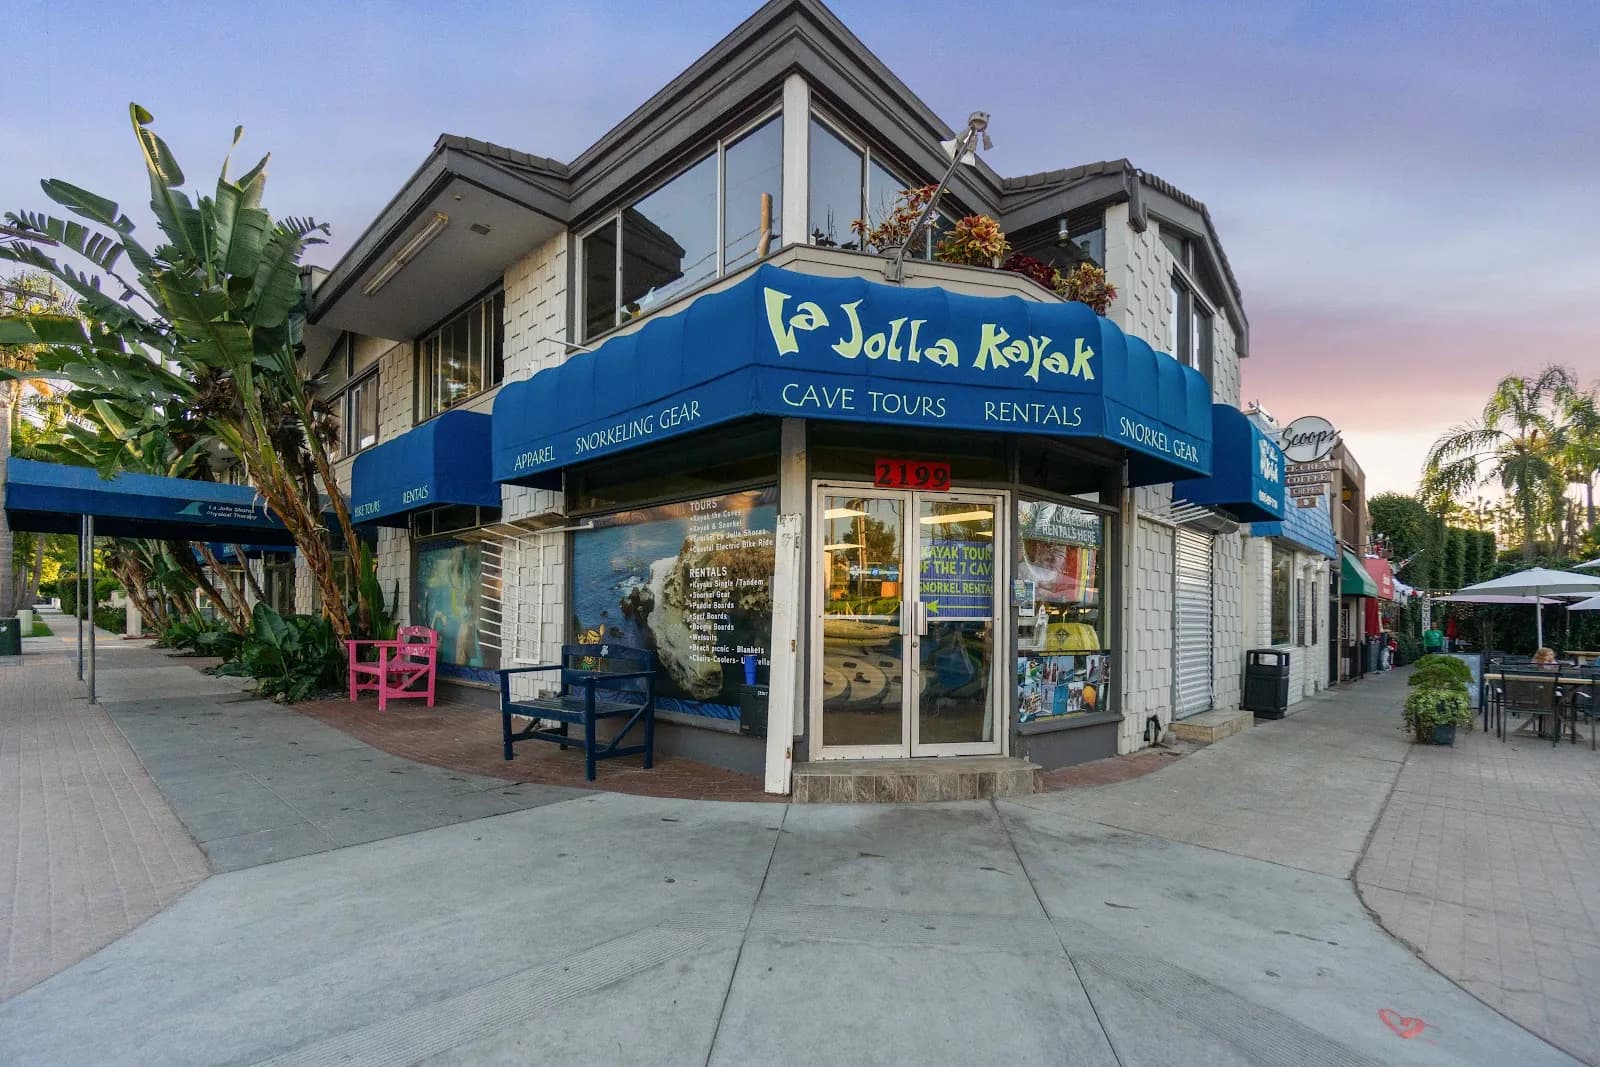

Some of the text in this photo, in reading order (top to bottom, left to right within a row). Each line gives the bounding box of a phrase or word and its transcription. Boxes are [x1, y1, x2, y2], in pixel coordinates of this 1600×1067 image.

[764, 287, 1096, 383] La Jolla Kayak
[782, 383, 1082, 427] CAVE TOURS RENTALS
[514, 400, 701, 471] APPAREL SNORKELING GEAR
[1120, 416, 1199, 463] SNORKEL GEAR
[1282, 427, 1342, 456] Scoops
[1284, 460, 1337, 473] CE CREAM
[877, 463, 948, 488] 2199
[1287, 473, 1328, 484] COFFEE
[402, 485, 429, 504] RENTALS
[690, 500, 718, 511] TOURS
[719, 520, 742, 530] Snorkel
[1042, 521, 1097, 545] RENTALS HERE
[715, 542, 741, 551] Electric
[758, 538, 774, 547] Ride
[921, 545, 959, 560] KAYAK
[689, 566, 728, 578] RENTALS
[934, 560, 957, 574] THE
[960, 561, 967, 575] 7
[714, 579, 734, 588] Single
[962, 582, 993, 595] RENTA
[706, 612, 728, 620] Boards
[713, 623, 735, 631] Boards
[692, 643, 710, 651] Beach
[736, 645, 765, 653] Blankets
